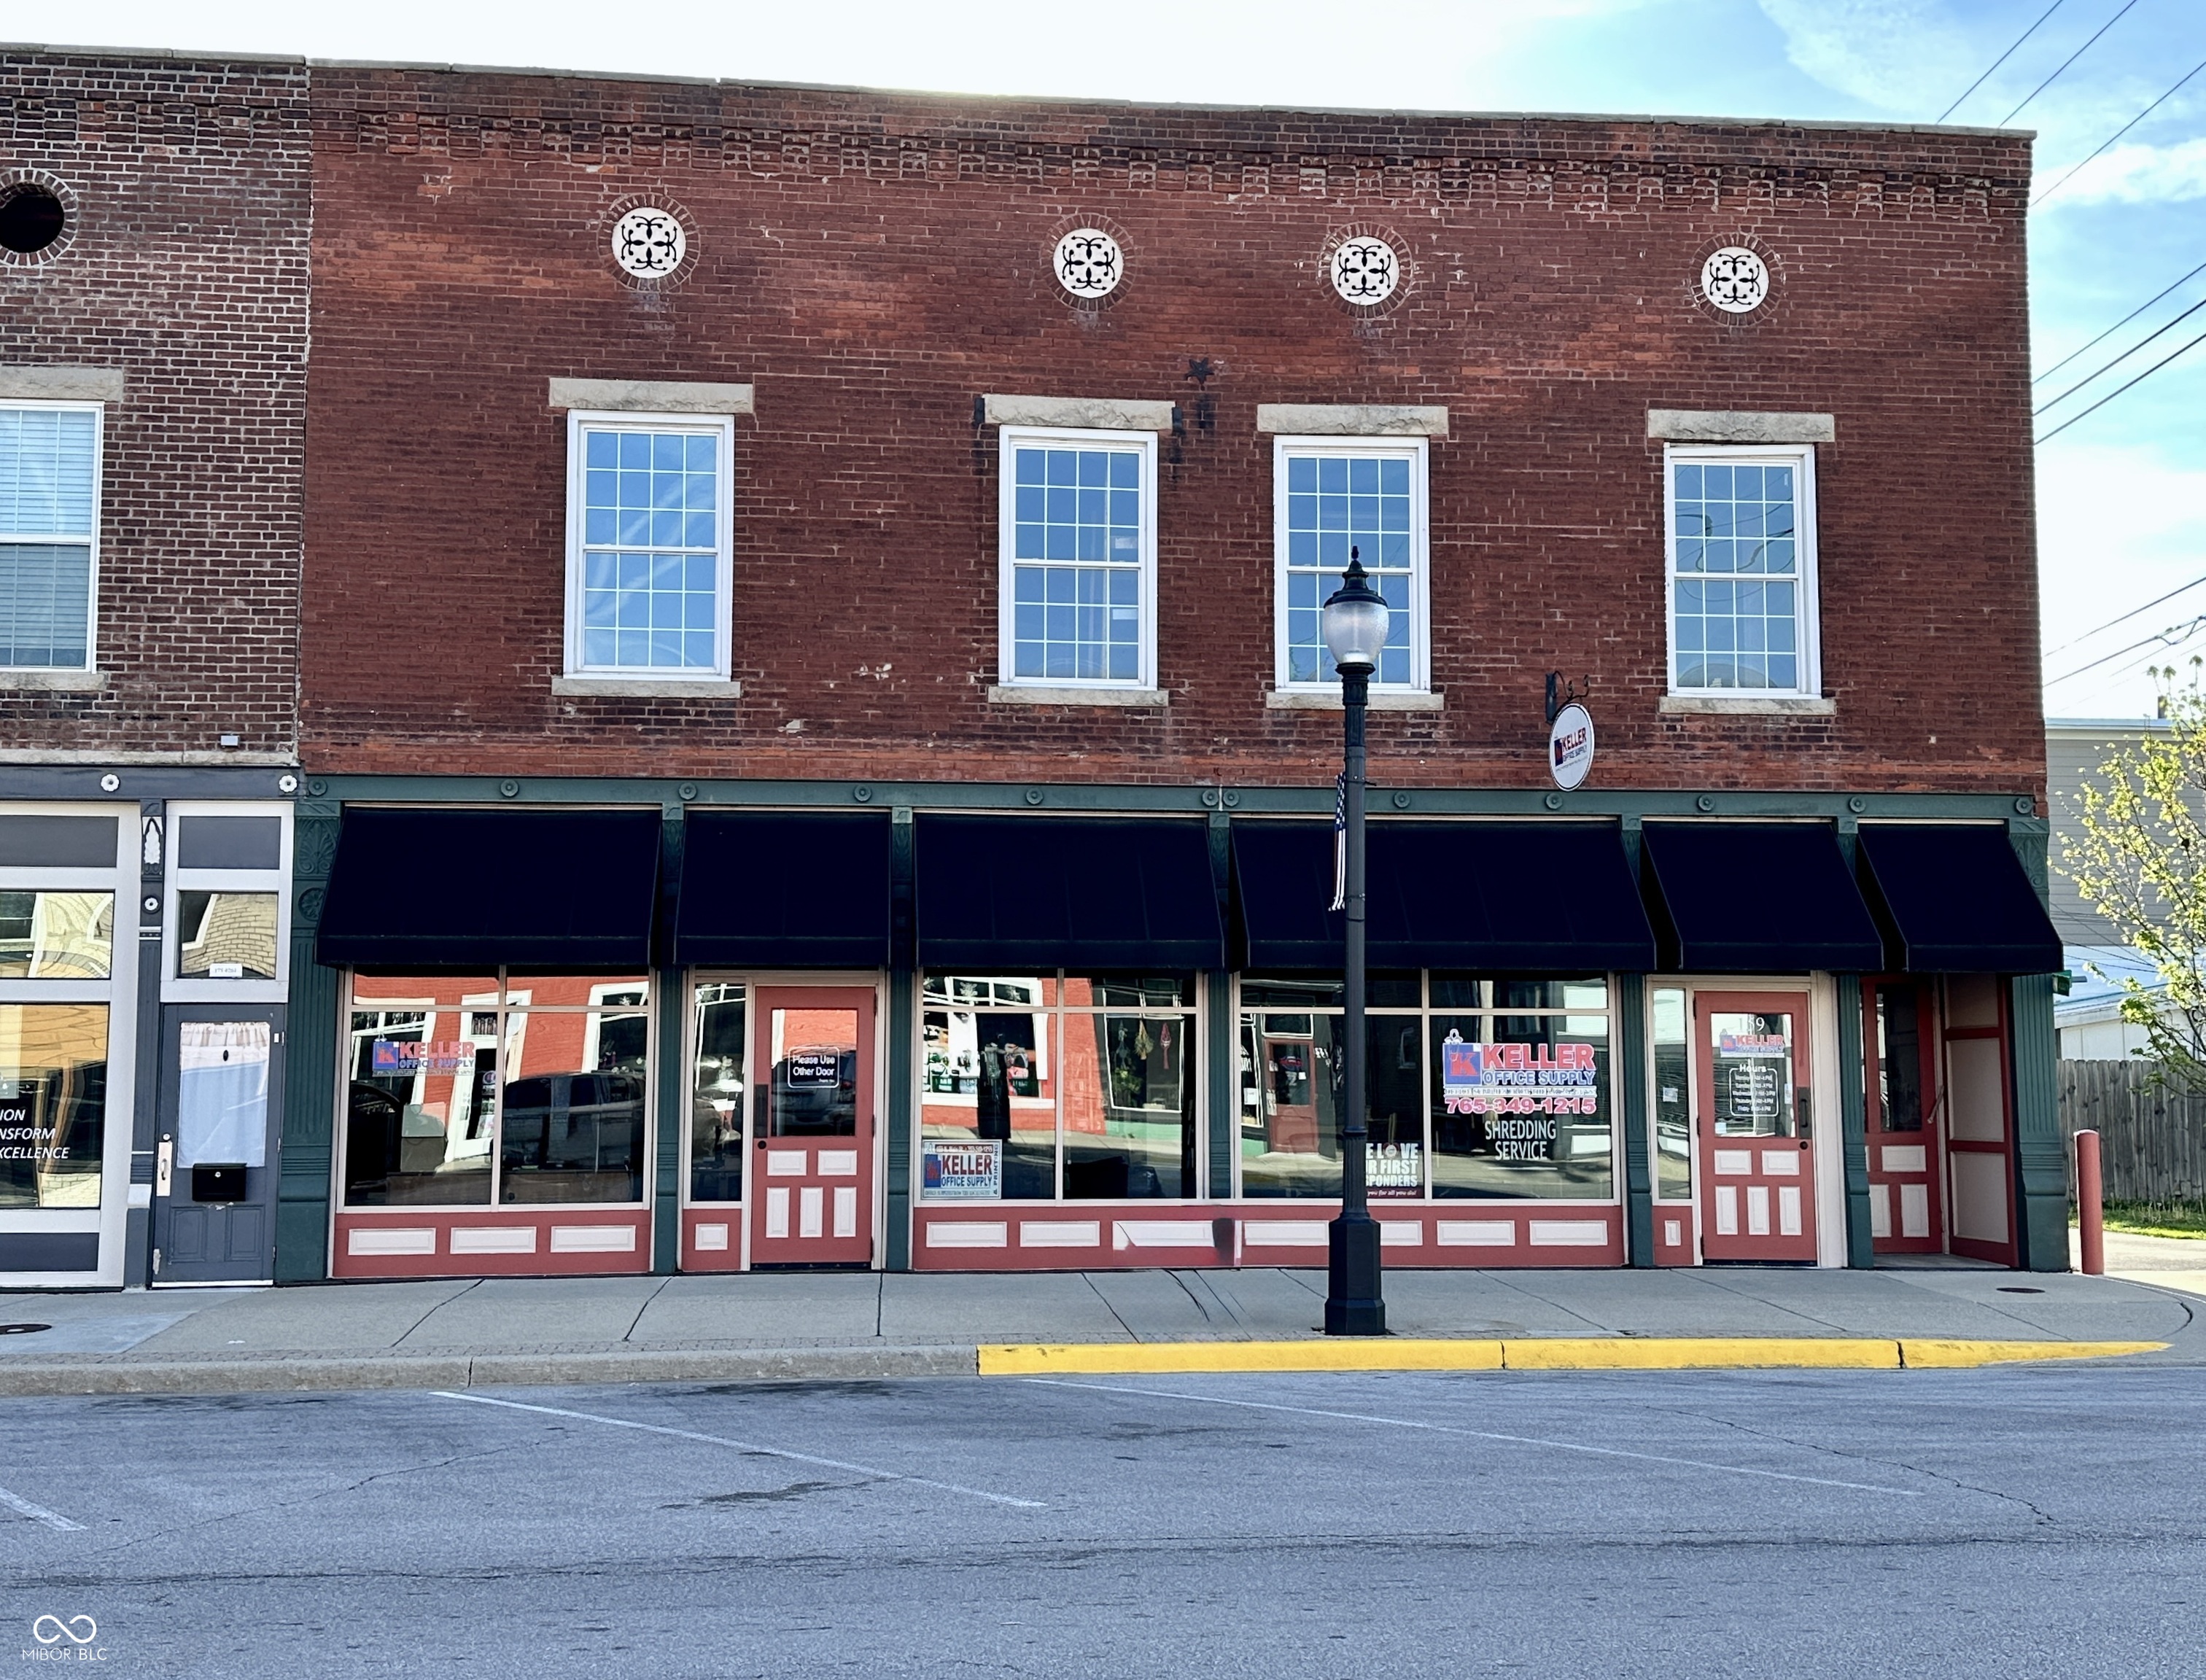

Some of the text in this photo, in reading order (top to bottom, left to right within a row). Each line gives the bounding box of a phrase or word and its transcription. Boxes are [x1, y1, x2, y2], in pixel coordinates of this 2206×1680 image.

[1562, 727, 1587, 752] KELLER
[1736, 1035, 1784, 1046] KELLER
[399, 1041, 475, 1058] KELLER
[1482, 1043, 1596, 1070] KELLER
[399, 1059, 475, 1069] OFFICE SUPPLY
[792, 1054, 836, 1065] Please Use
[792, 1066, 835, 1076] Other Door
[1739, 1063, 1767, 1073] Hours
[1483, 1070, 1596, 1086] OFFICE SUPPLY
[1445, 1097, 1597, 1114] 765-349-1215
[1485, 1120, 1556, 1140] SHREDDING
[1495, 1140, 1547, 1161] SERVICE
[942, 1154, 993, 1175] KELLER
[1380, 1159, 1418, 1175] FIRST
[941, 1176, 993, 1187] OFFICE SUPPLY
